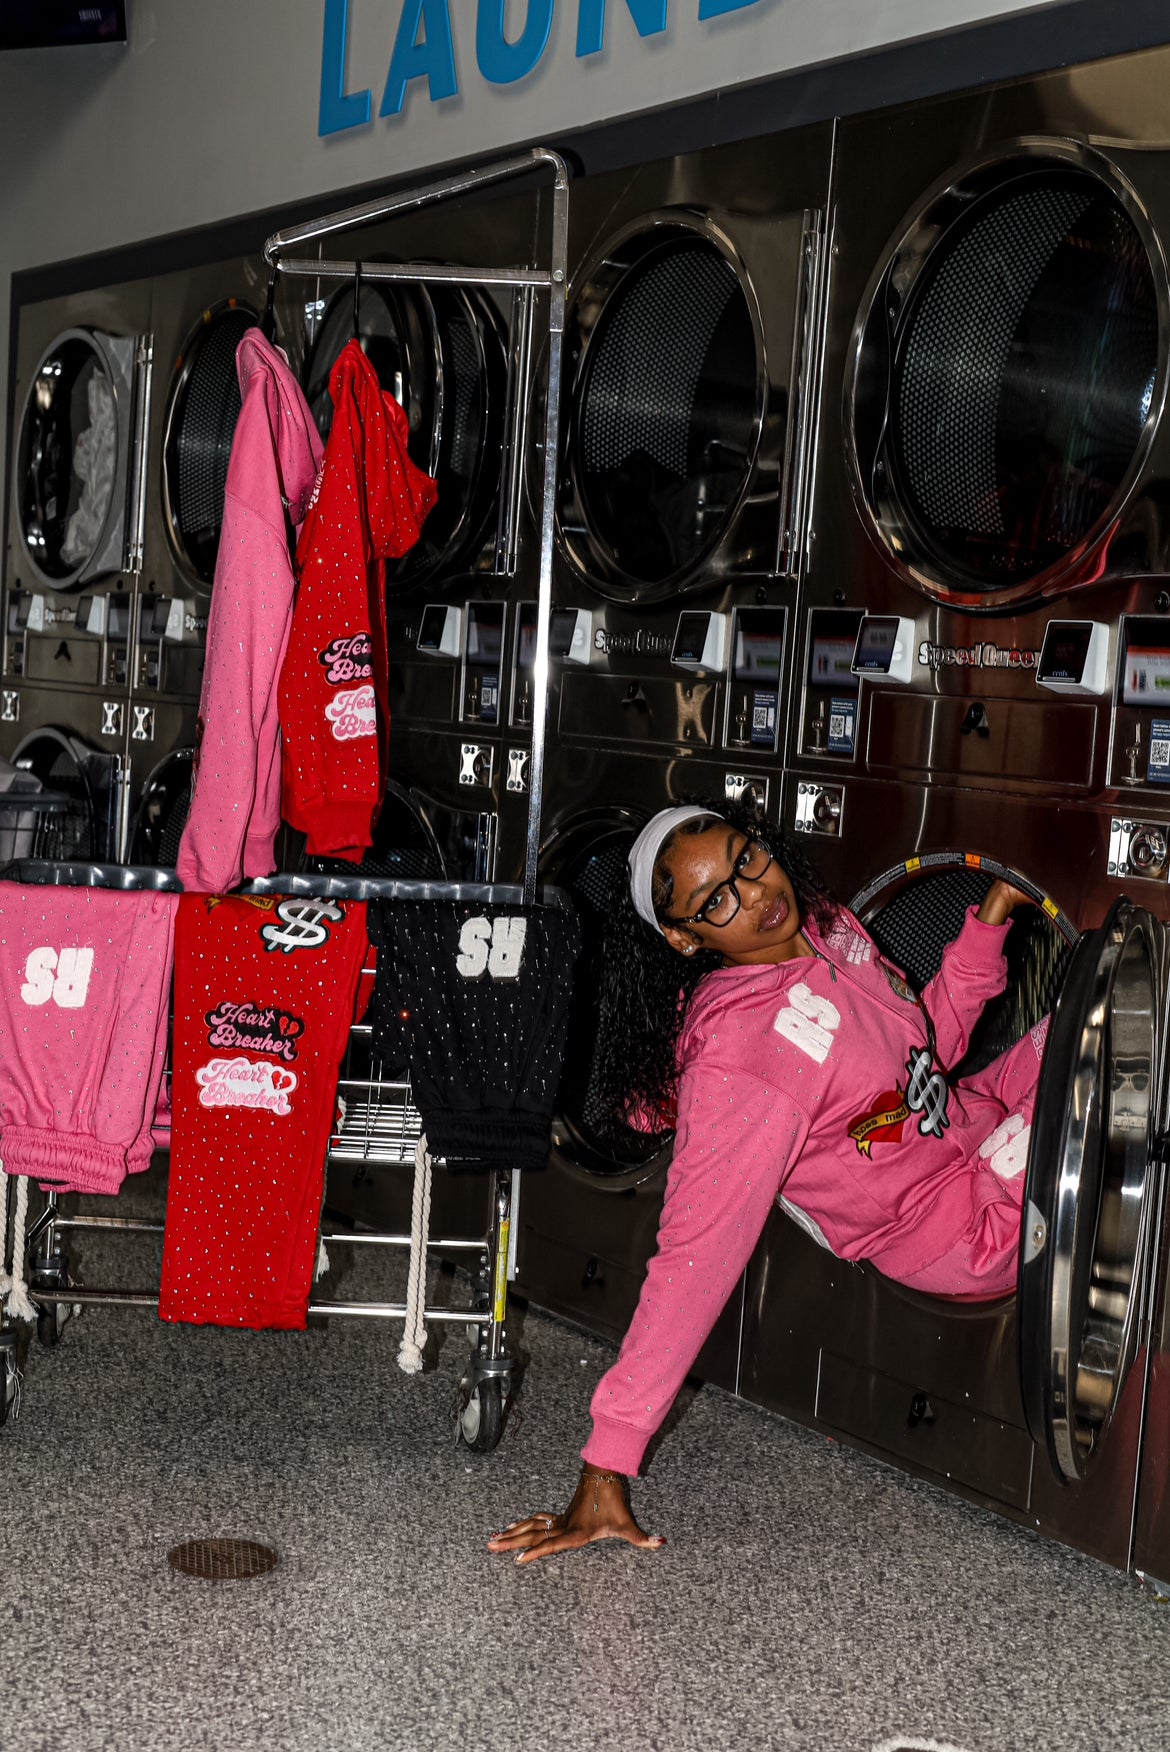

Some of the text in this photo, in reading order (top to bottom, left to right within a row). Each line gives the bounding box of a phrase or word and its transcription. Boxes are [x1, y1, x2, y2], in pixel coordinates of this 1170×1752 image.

[325, 633, 372, 663] Hea
[919, 642, 981, 671] Speed
[331, 687, 376, 717] Hea
[210, 1002, 276, 1029] Heart
[209, 1023, 294, 1061] Breaker
[202, 1061, 269, 1083] Heart
[202, 1081, 290, 1116] Breaker
[853, 1106, 907, 1137] hoes mad
